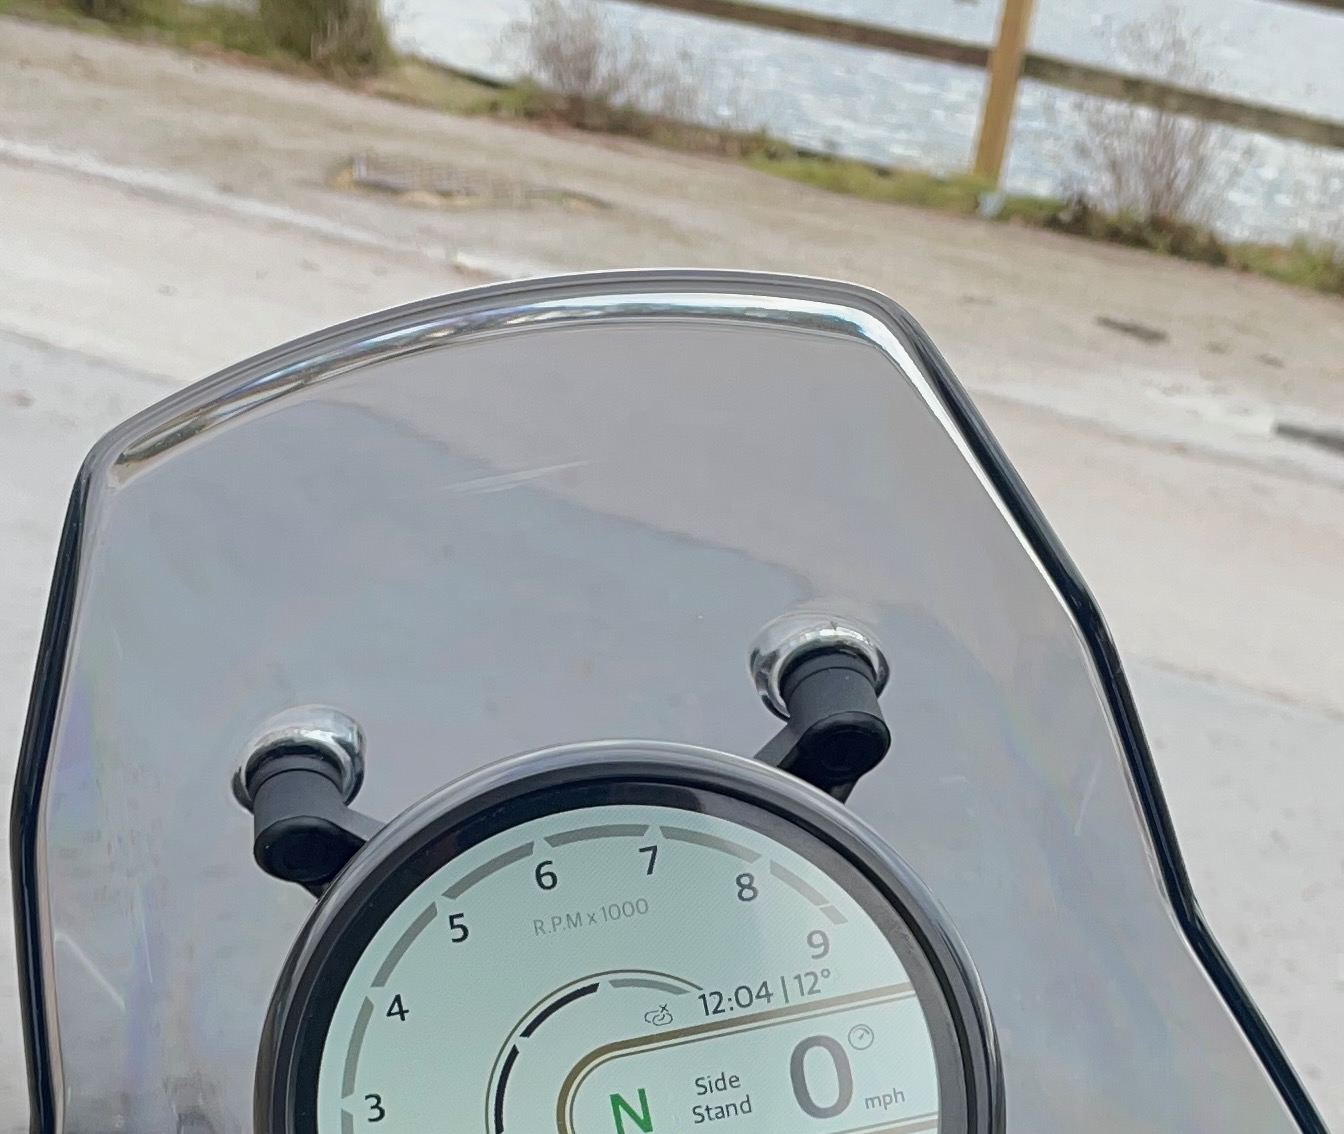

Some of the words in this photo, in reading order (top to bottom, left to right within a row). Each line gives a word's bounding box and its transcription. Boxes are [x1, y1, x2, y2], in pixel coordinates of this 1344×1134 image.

[535, 860, 558, 890] 6
[639, 846, 660, 876] 7
[735, 873, 759, 902] 8
[449, 913, 470, 944] 5
[806, 929, 831, 959] 9
[698, 980, 774, 1017] 12:04
[793, 968, 832, 997] 12°
[386, 994, 410, 1023] 4
[694, 1071, 742, 1096] Side
[789, 1035, 854, 1119] 0
[365, 1093, 386, 1123] 3
[692, 1094, 753, 1125] Stand
[864, 1087, 906, 1112] mph
